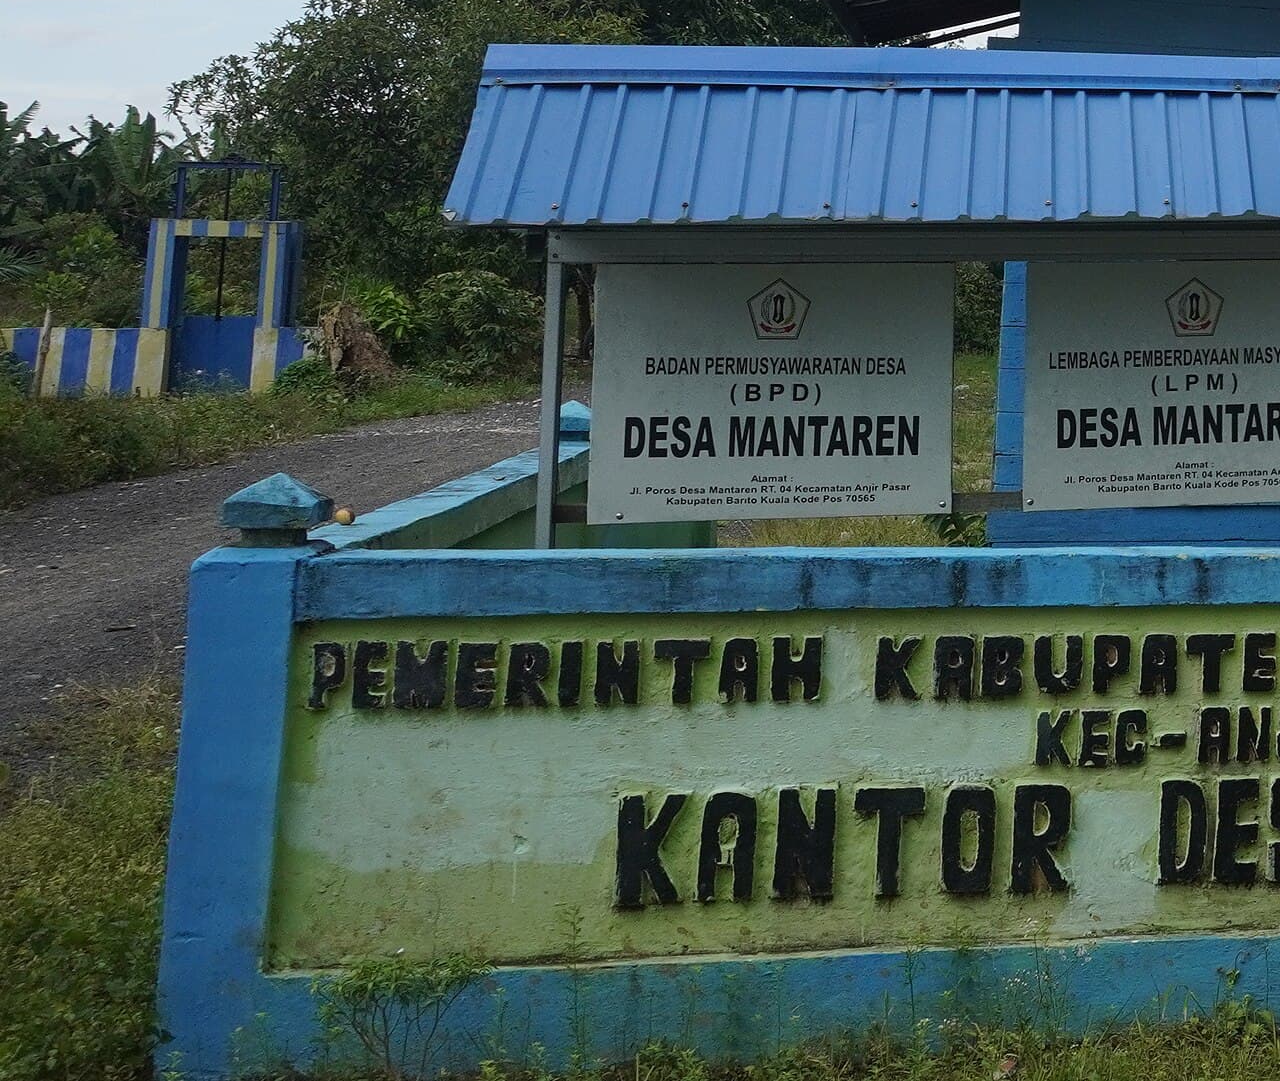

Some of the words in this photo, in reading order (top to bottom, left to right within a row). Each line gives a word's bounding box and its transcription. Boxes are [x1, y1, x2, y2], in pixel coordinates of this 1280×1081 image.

[645, 357, 700, 376] BADAN
[705, 357, 862, 376] PERMUSYAWARATAN
[866, 357, 906, 376] DESA
[1049, 350, 1120, 370] LEMBAGA
[1124, 347, 1239, 368] PEMBERDAYAAN
[624, 416, 716, 458] DESA
[728, 415, 920, 458] MANTAREN
[1056, 407, 1142, 448] DESA
[1078, 475, 1107, 483] Poros
[1110, 474, 1134, 482] Desa
[1137, 472, 1182, 481] Mantaren
[1216, 469, 1268, 478] Kecamatan
[1098, 484, 1150, 493] Kabupaten
[1153, 482, 1182, 491] Barito
[1185, 481, 1212, 489] Kuala
[1214, 480, 1239, 488] Kode
[1242, 479, 1259, 487] Pos
[645, 487, 676, 495] Poros
[680, 486, 706, 494] Desa
[709, 486, 757, 494] Mantaren
[779, 485, 792, 493] 04
[795, 485, 851, 493] Kecamatan
[854, 484, 879, 494] Anjir
[882, 483, 911, 491] Pasar
[666, 497, 723, 507] Kabupaten
[726, 496, 757, 504] Barito
[760, 496, 790, 504] Kuala
[793, 495, 820, 503] Kode
[823, 495, 842, 503] Pos
[845, 494, 876, 502] 70565
[306, 635, 824, 711] PEMERINTAH
[613, 784, 1072, 908] KANTOR
